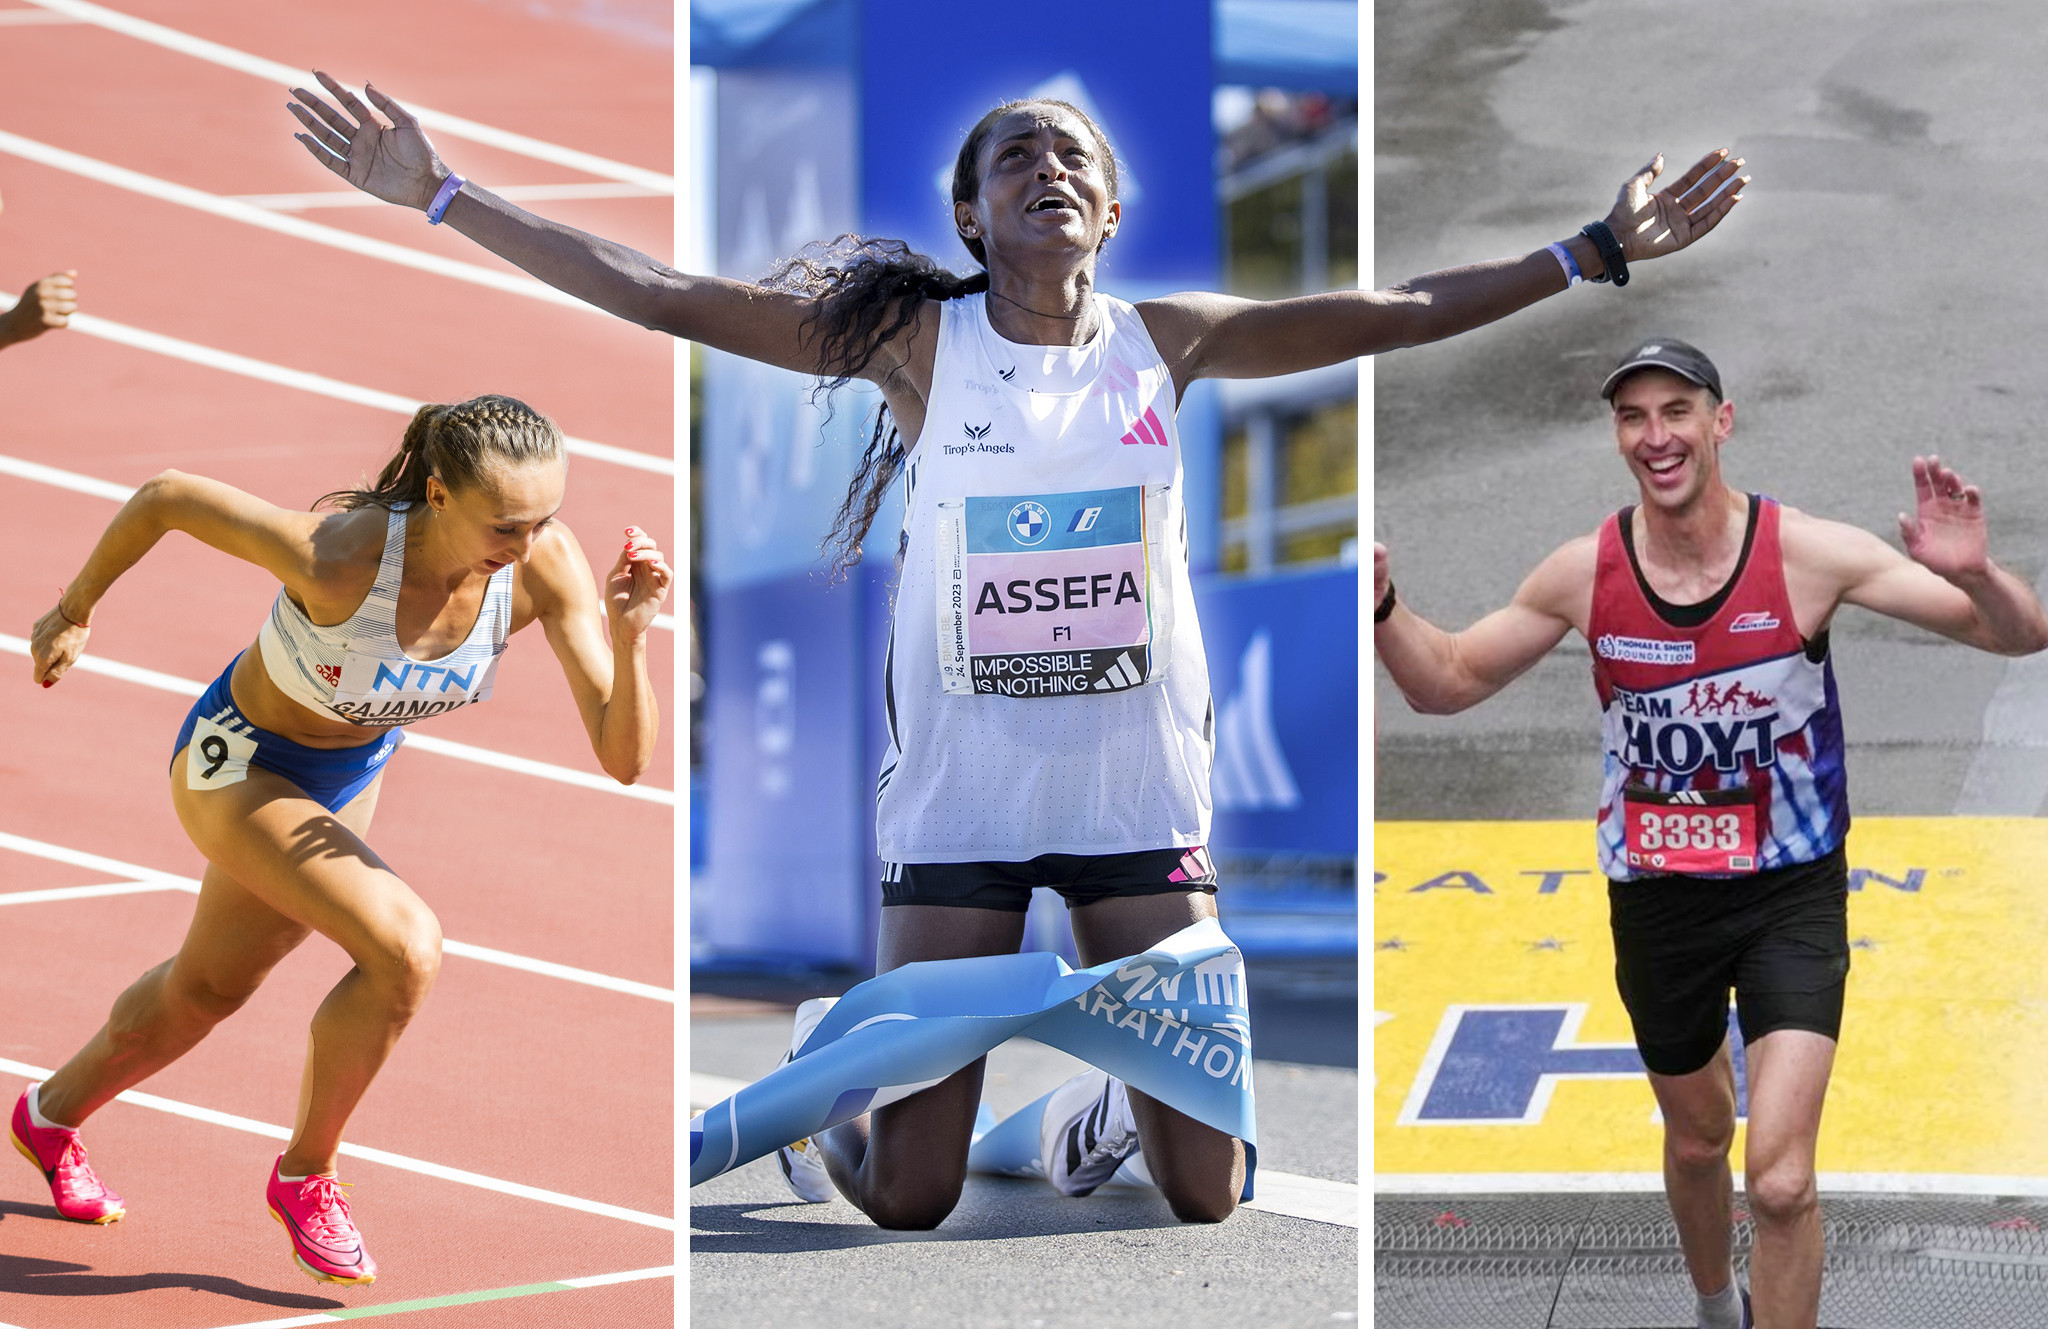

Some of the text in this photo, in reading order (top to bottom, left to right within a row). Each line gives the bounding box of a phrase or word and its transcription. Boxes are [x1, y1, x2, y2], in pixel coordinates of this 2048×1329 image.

[943, 442, 1015, 455] Tirop's Angels
[1013, 504, 1044, 517] BMW
[974, 571, 1142, 615] ASSEFA
[952, 583, 965, 678] 24. September 2023
[1053, 626, 1071, 642] F1
[1618, 640, 1693, 652] THOMAS E. SMITH
[1618, 650, 1693, 662] FOUNDATION
[372, 661, 478, 693] NTN
[974, 653, 1093, 676] IMPOSSIBLE
[976, 674, 1088, 695] IS NOTHING
[1619, 690, 1672, 719] TEAM
[1622, 712, 1780, 772] HOYT
[200, 735, 229, 780] 9
[1639, 811, 1741, 851] 3333
